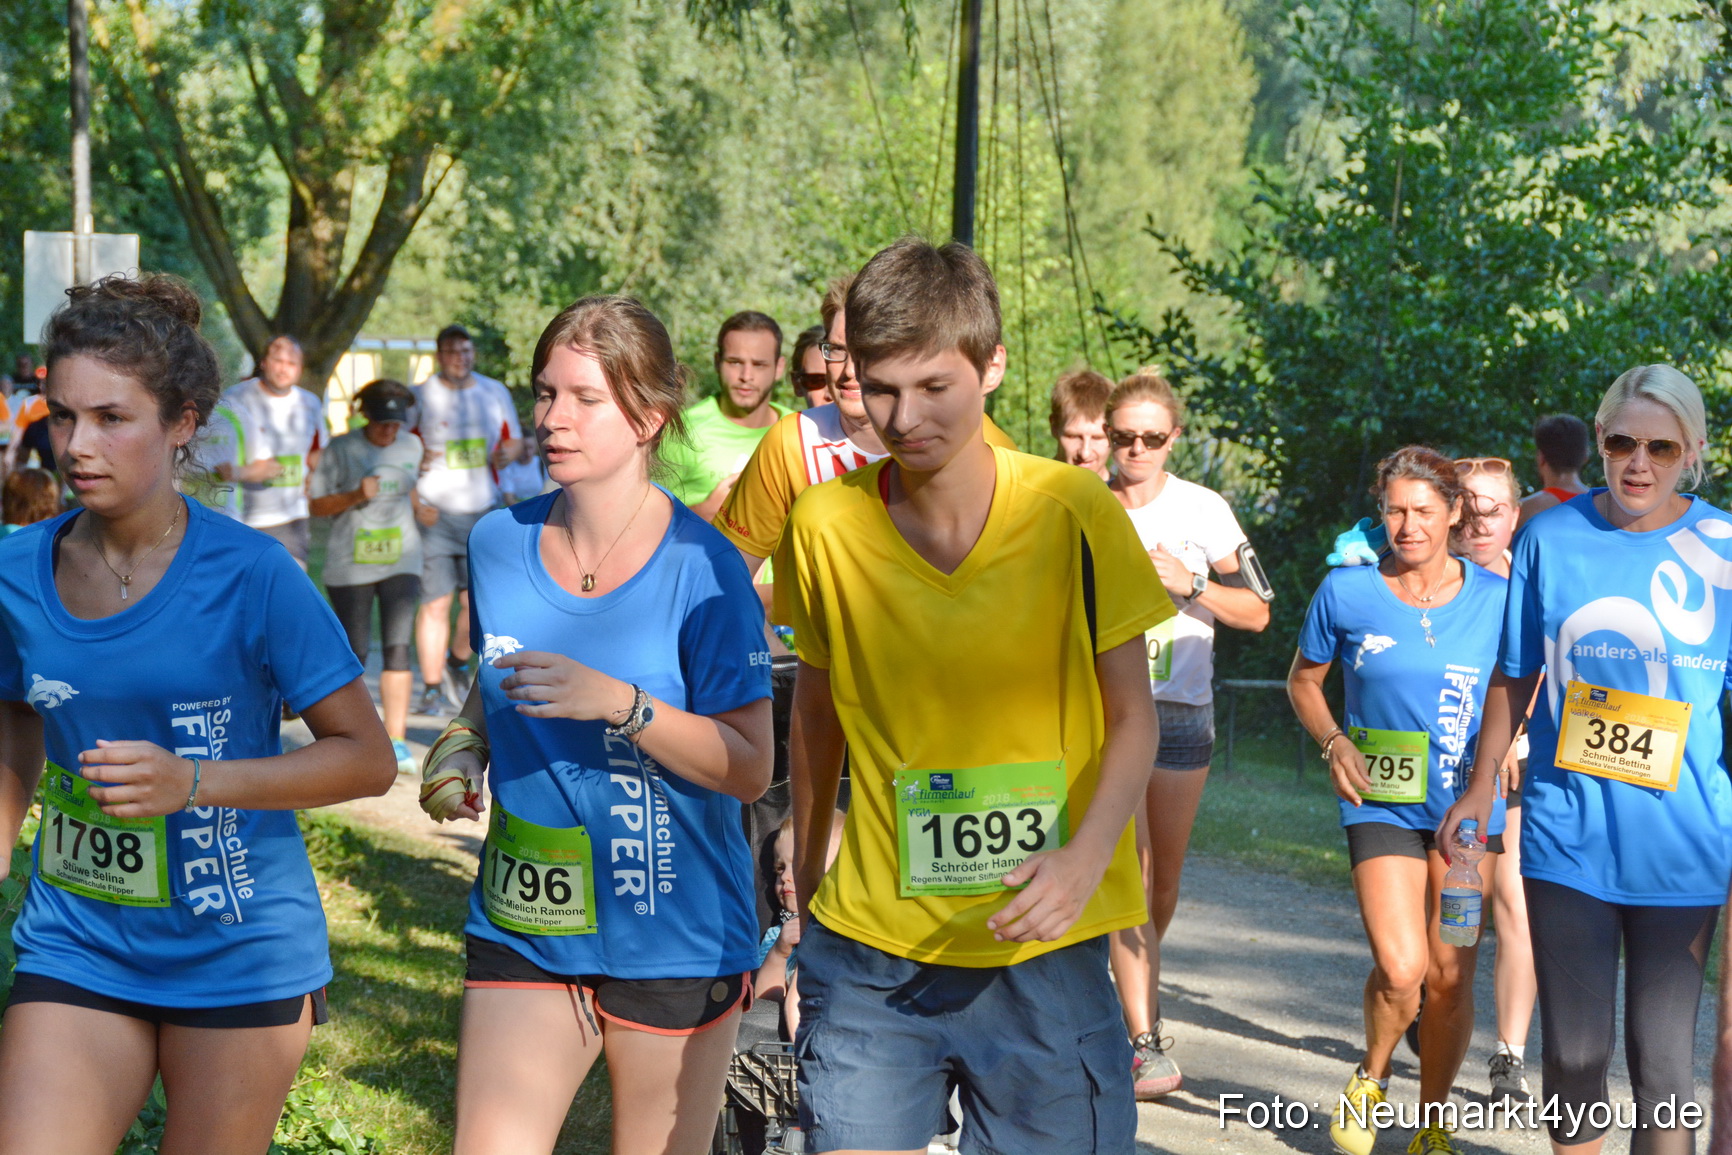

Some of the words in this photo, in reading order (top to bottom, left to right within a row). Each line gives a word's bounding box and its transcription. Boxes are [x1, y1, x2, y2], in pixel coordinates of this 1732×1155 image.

[748, 651, 772, 667] BEC
[1147, 638, 1160, 660] 0
[1573, 642, 1636, 660] anders
[1642, 647, 1668, 664] als
[172, 700, 220, 711] POWERED
[222, 696, 232, 705] BY
[1580, 697, 1622, 712] firmenlauf
[1437, 672, 1465, 789] FLIPPER
[1585, 718, 1653, 760] 384
[1365, 753, 1414, 782] 795
[1579, 758, 1602, 768] Debeka
[1603, 763, 1651, 778] Versicherungen
[1582, 750, 1616, 763] Schmid
[1618, 757, 1651, 771] Bettina
[919, 786, 976, 799] firmenlauf
[171, 715, 227, 916] FLPER
[603, 733, 646, 896] LIPPER
[52, 812, 144, 873] 1798
[922, 807, 1046, 859] 1693
[518, 846, 540, 860] 2018
[62, 859, 90, 877] Stüwe
[92, 869, 125, 884] Selina
[490, 847, 572, 905] 1796
[931, 861, 989, 873] Schröder
[992, 858, 1024, 869] Hann
[56, 869, 106, 891] Schwimmschule
[107, 884, 134, 895] Flipper
[911, 875, 942, 884] Regens
[944, 875, 976, 884] Wagner
[534, 917, 562, 927] Flipper
[540, 906, 586, 916] Ramone
